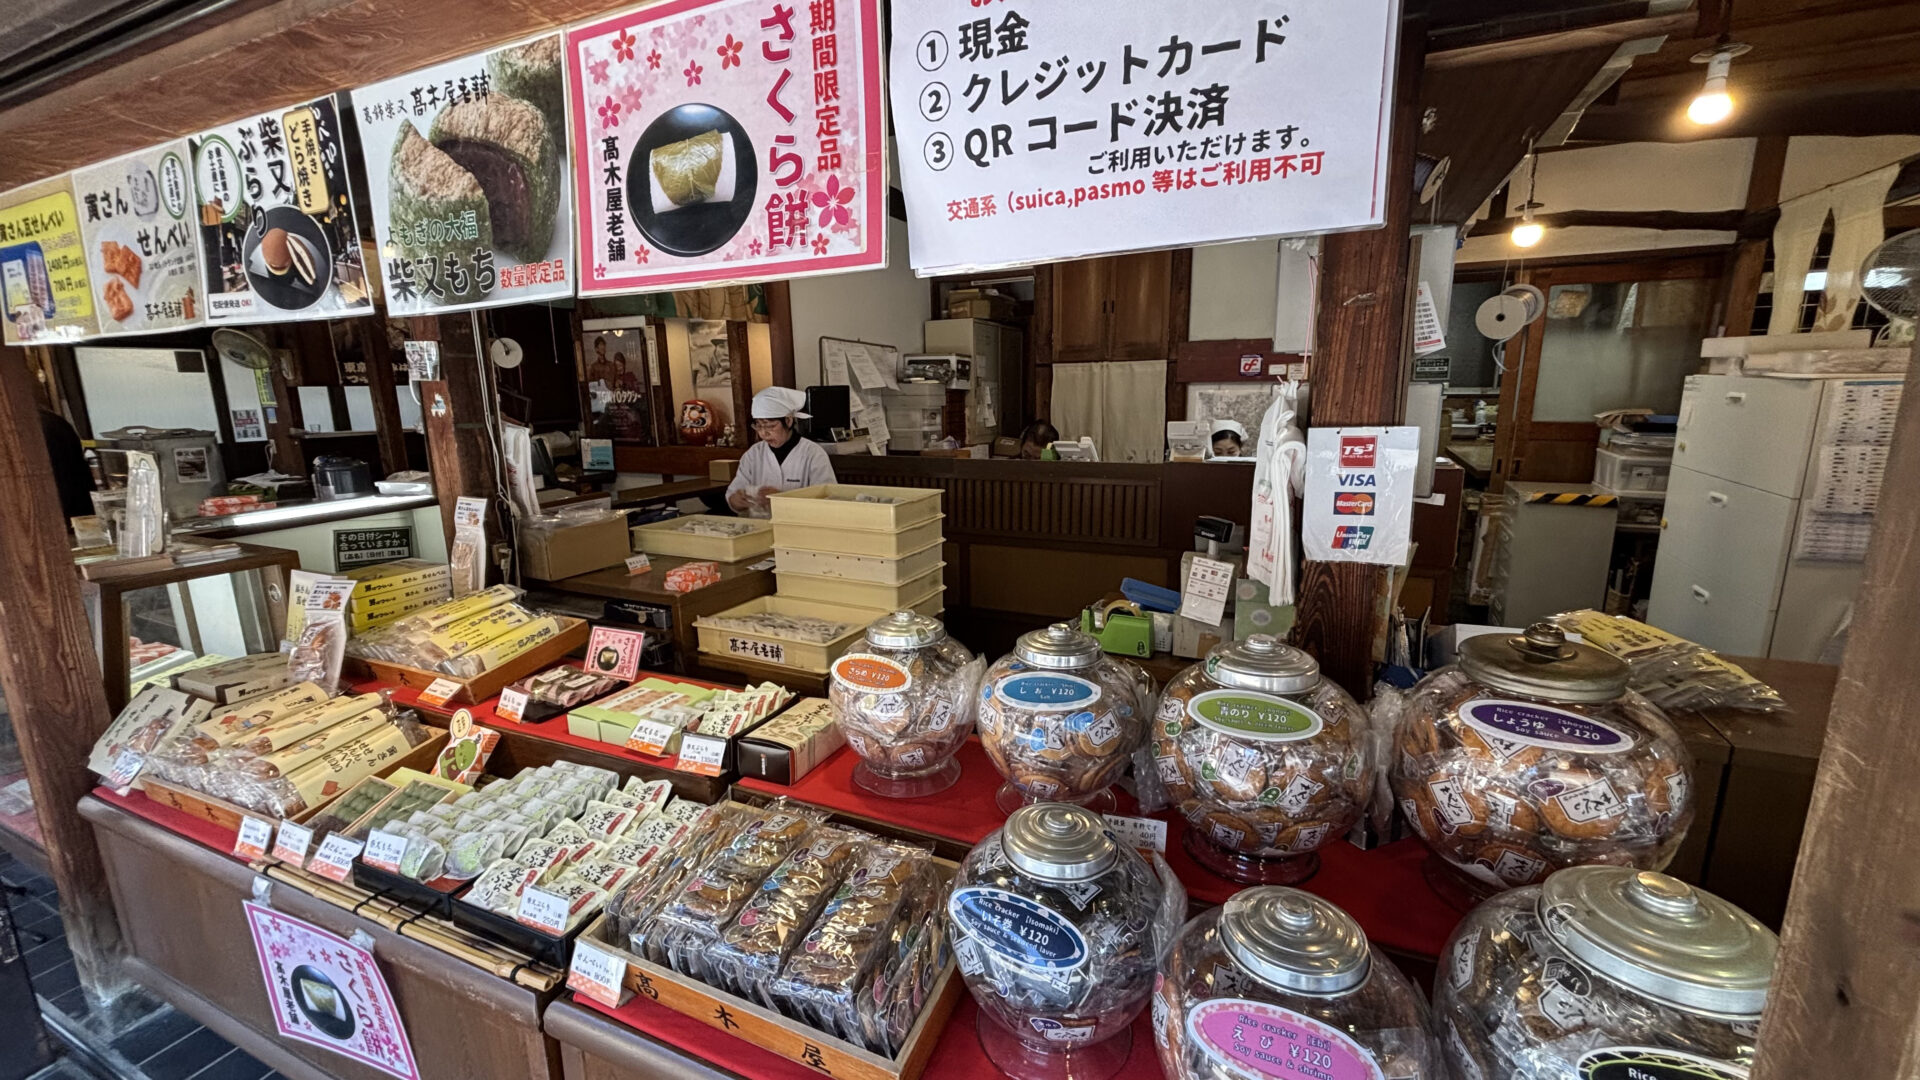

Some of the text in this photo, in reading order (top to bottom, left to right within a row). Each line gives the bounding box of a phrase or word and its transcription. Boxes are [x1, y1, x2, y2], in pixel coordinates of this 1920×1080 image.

[959, 10, 1030, 62] 現金
[961, 15, 1290, 114] クレジットカード
[808, 0, 841, 172] 期間限定品
[363, 99, 407, 124] 葛飾柴又
[759, 3, 809, 251] さくら餅
[258, 116, 291, 196] 柴又
[289, 121, 312, 207] どら焼き
[301, 118, 318, 174] 手焼き
[1088, 124, 1311, 175] ご利用いただけます。
[1152, 151, 1325, 192] 等はご利用不可
[84, 187, 128, 223] 寅さん
[137, 222, 191, 256] せんべい
[386, 209, 478, 247] よもぎの大福
[388, 248, 496, 302] 柴又もち
[500, 259, 566, 288] 数量限定品
[1337, 474, 1376, 487] VISA
[340, 531, 400, 541] その日付シール
[1336, 531, 1371, 540] UnionPay
[1221, 706, 1249, 718] 青のり
[1493, 713, 1600, 741] しょうゆ ¥120
[1517, 711, 1549, 721] cracker
[978, 898, 993, 909] Rice
[994, 903, 1020, 919] cracker
[981, 909, 1049, 946] いそ巻 ¥120
[983, 924, 1001, 935] sauce
[1039, 945, 1057, 958] laver
[336, 949, 387, 1060] さくら餅
[1238, 1014, 1258, 1028] Rice
[1262, 1023, 1297, 1039] cracker
[1233, 1042, 1334, 1080] Soy sauce & shrimp
[1289, 1043, 1331, 1069] ¥120
[1628, 1067, 1657, 1080] Rice
